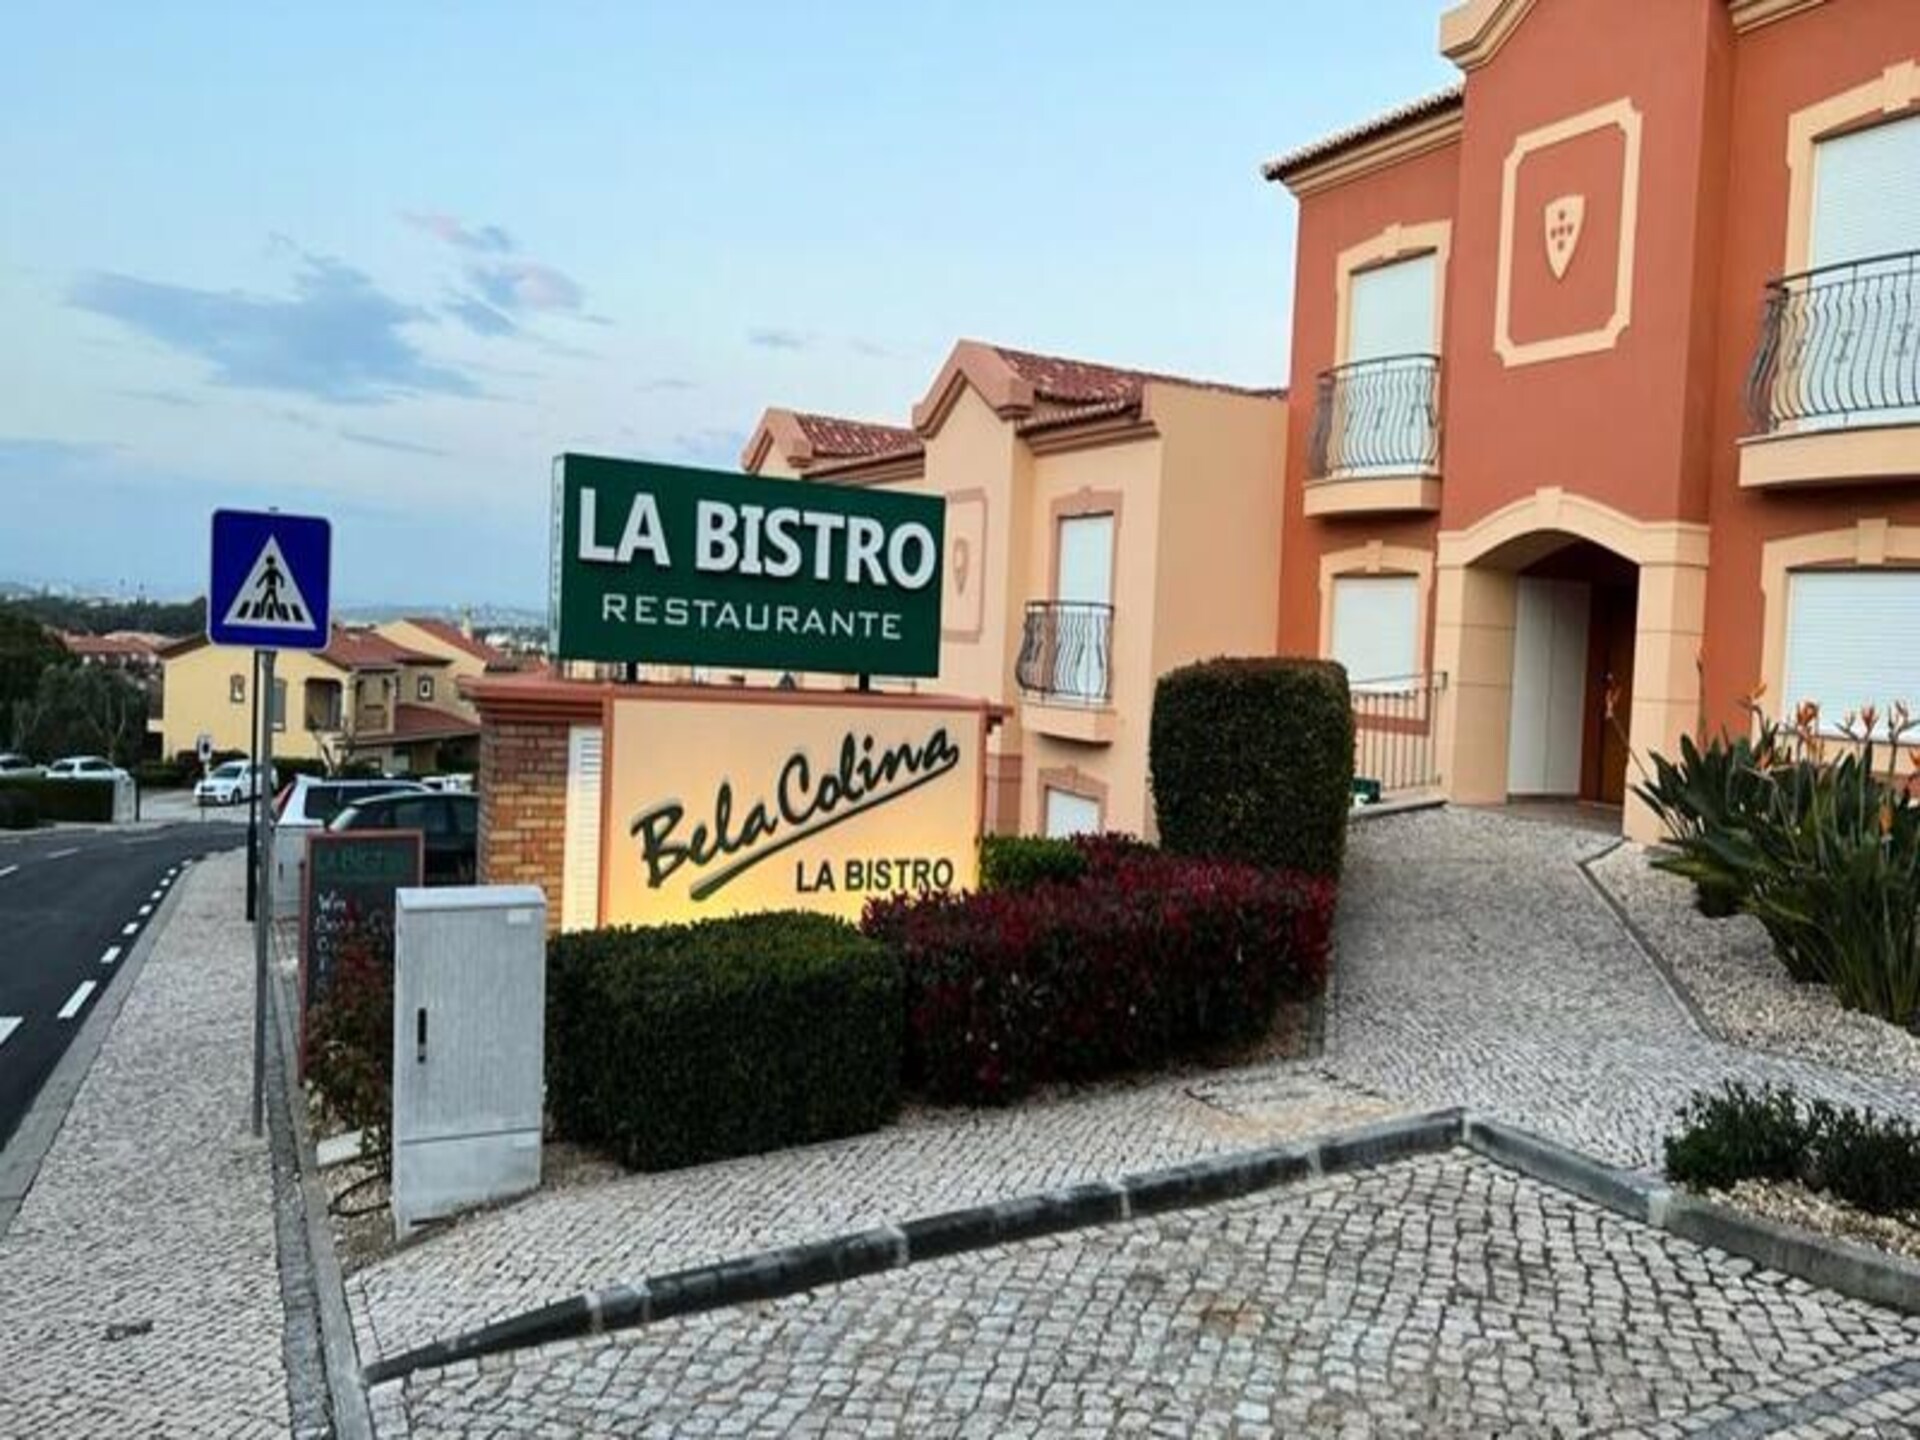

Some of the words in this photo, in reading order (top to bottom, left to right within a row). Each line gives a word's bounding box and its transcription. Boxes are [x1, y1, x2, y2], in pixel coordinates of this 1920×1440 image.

[578, 487, 671, 567] LA
[695, 499, 937, 590] BISTRO
[602, 592, 903, 640] RESTAURANTE
[796, 861, 835, 893] LA
[845, 858, 954, 892] BISTRO
